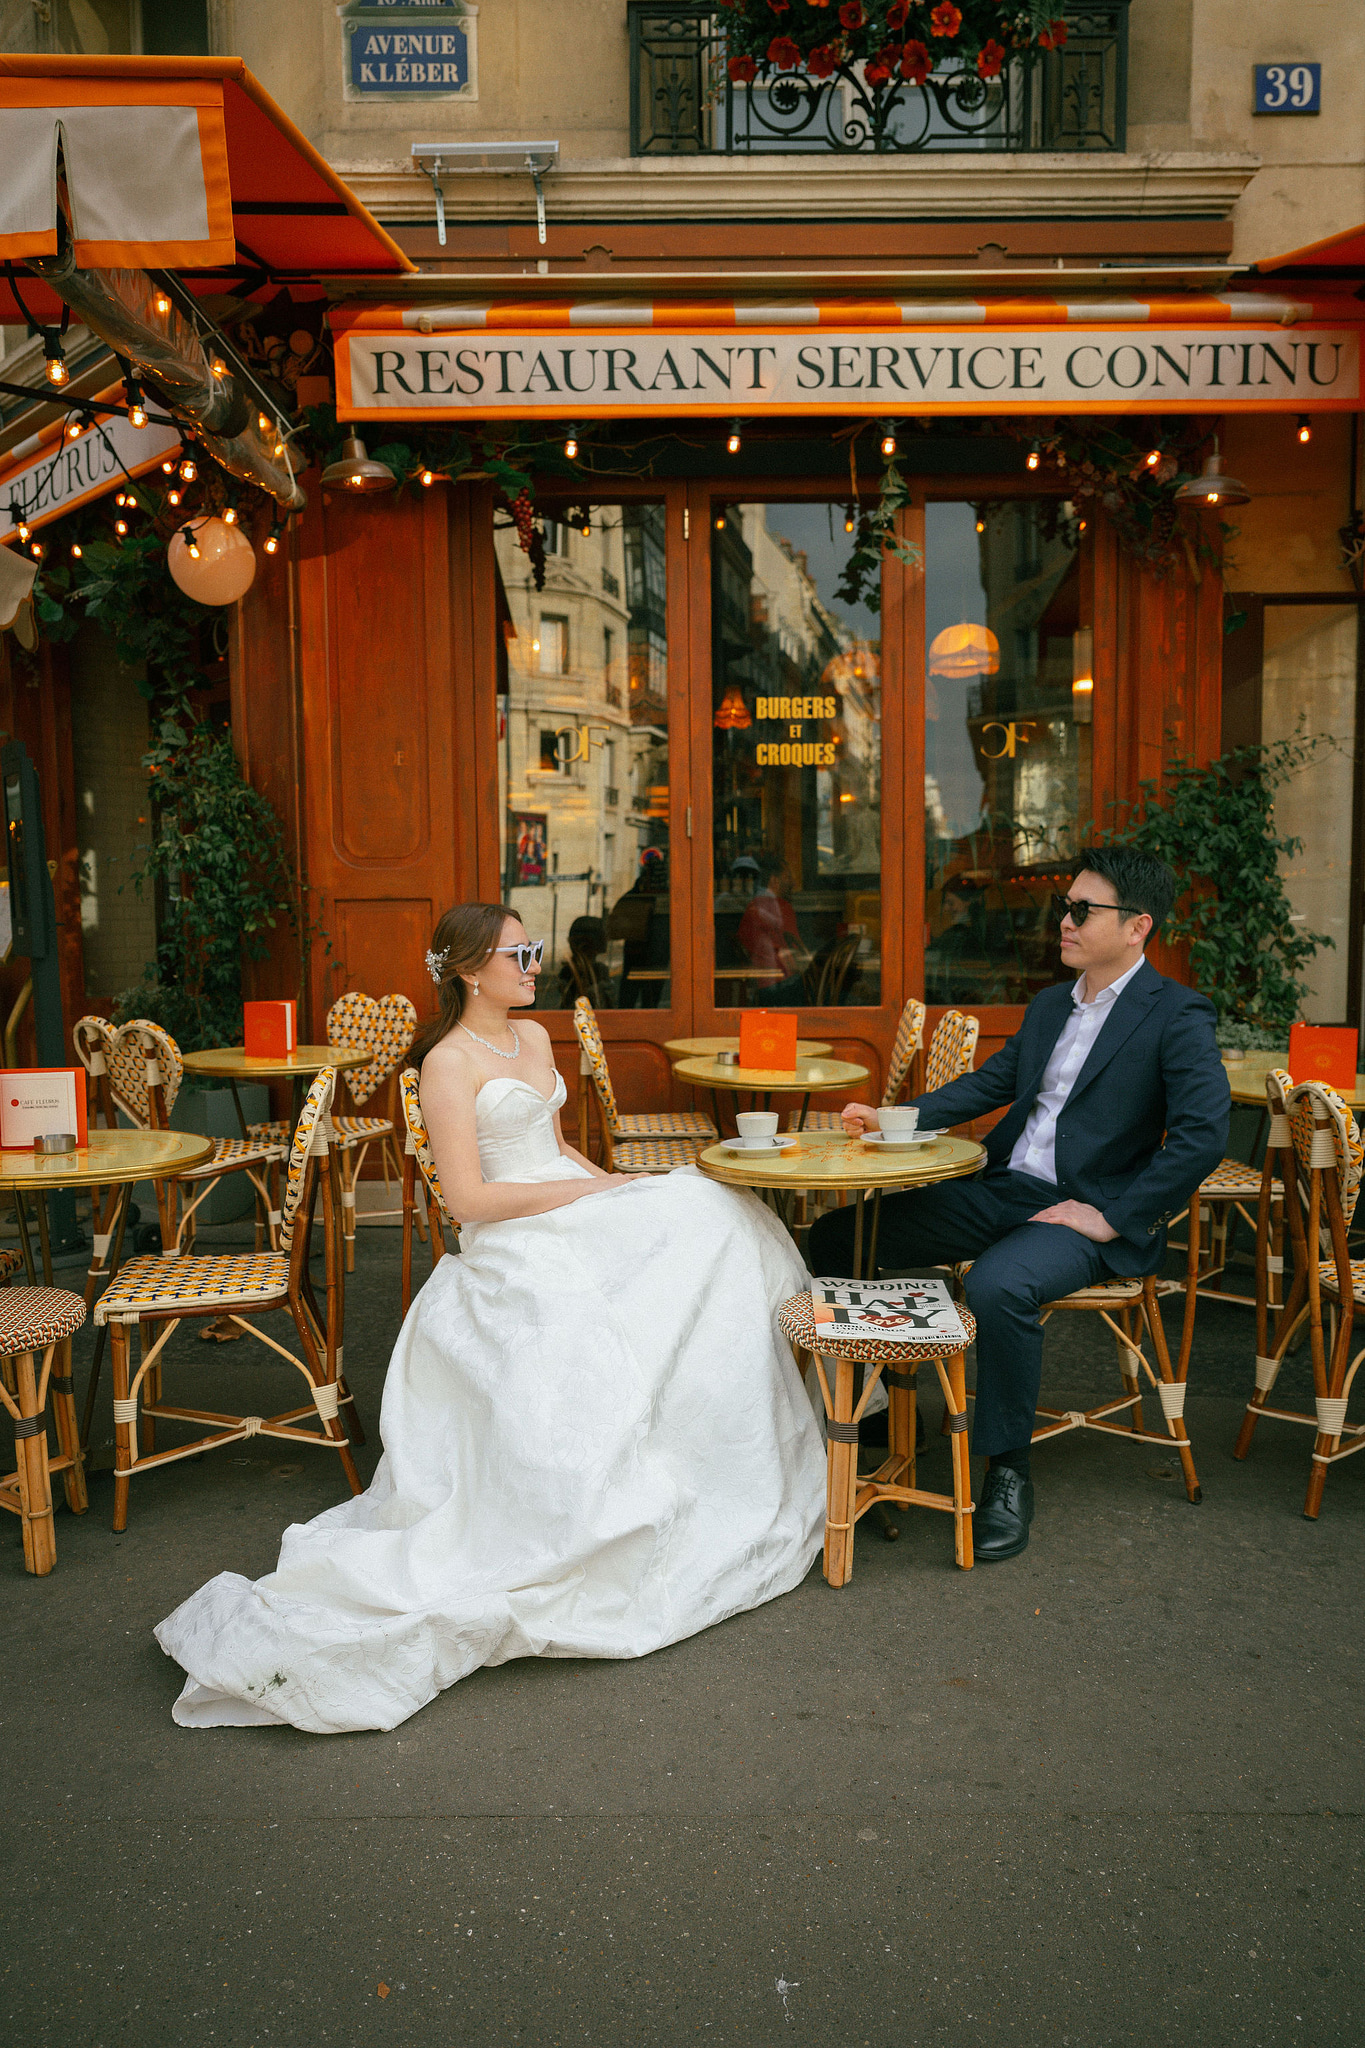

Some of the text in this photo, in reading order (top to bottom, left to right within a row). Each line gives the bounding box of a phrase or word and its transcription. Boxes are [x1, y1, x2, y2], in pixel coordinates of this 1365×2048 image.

[364, 34, 456, 55] AVENUE
[360, 57, 459, 83] KLÉBER
[1264, 66, 1314, 107] 39
[370, 343, 1344, 395] RESTAURANT SERVICE CONTINU
[756, 696, 836, 719] BURGERS
[789, 724, 802, 738] ET
[756, 743, 836, 768] CROQUES
